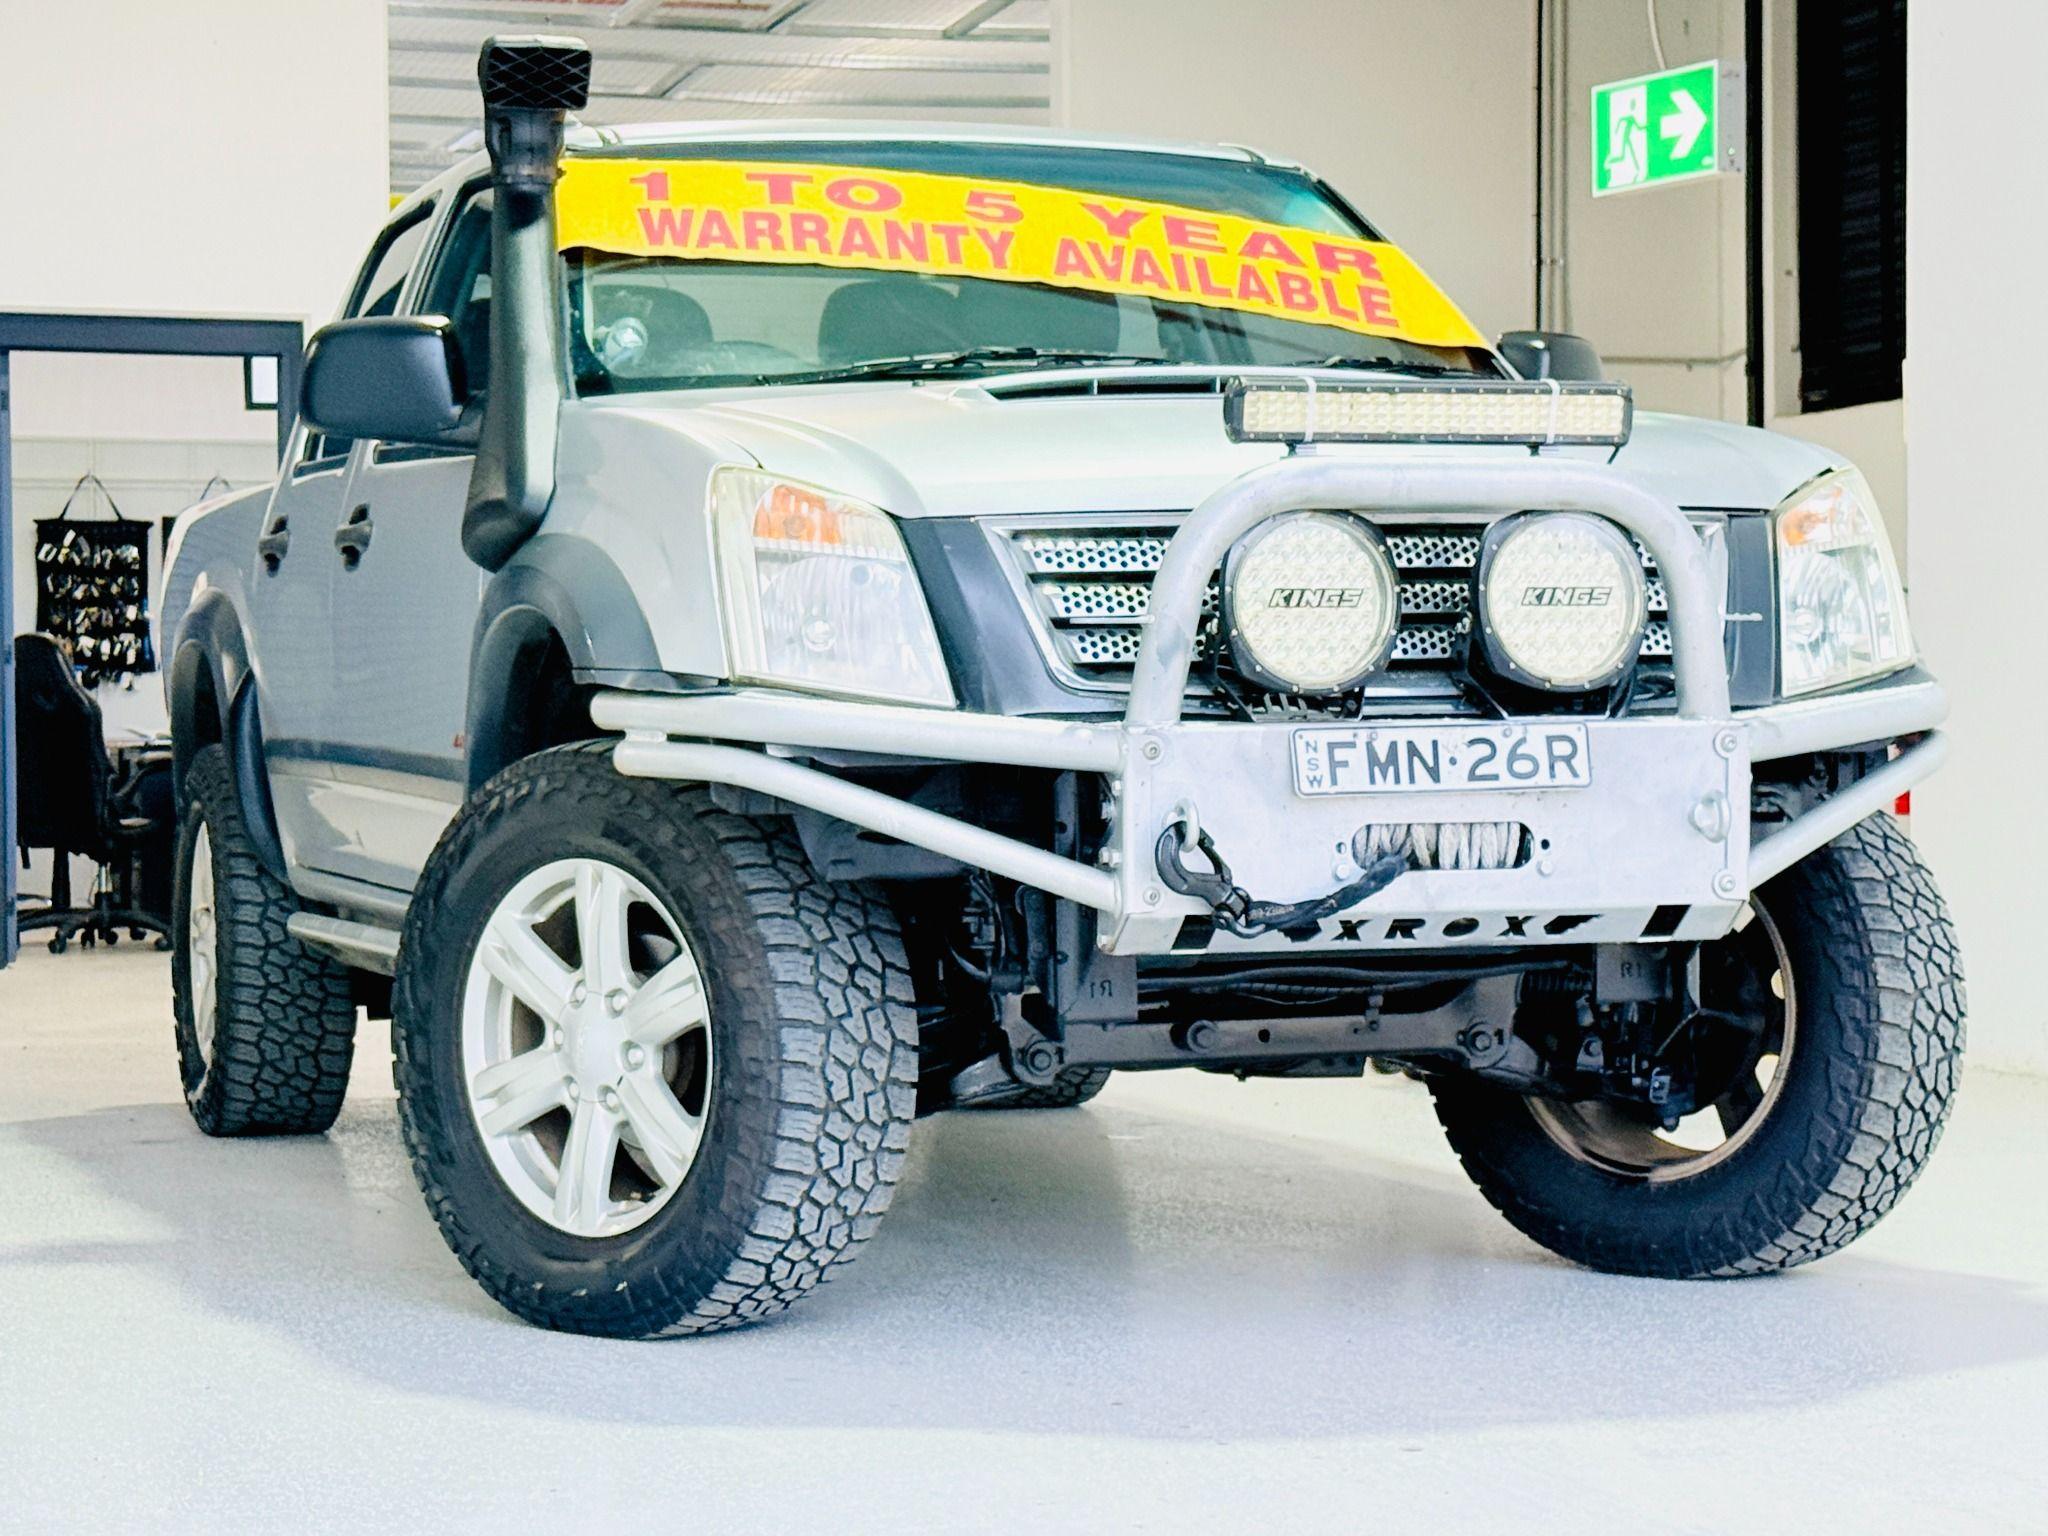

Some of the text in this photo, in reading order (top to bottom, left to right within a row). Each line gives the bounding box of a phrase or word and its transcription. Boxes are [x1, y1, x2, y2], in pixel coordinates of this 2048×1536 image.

[630, 171, 1384, 282] 1 TO 5 YEAR
[638, 208, 1400, 327] WARRANTY AVAILABLE
[1268, 588, 1364, 609] KINGS
[1521, 586, 1613, 607] KINGS
[1303, 740, 1323, 789] NSW
[1331, 914, 1538, 942] XROX
